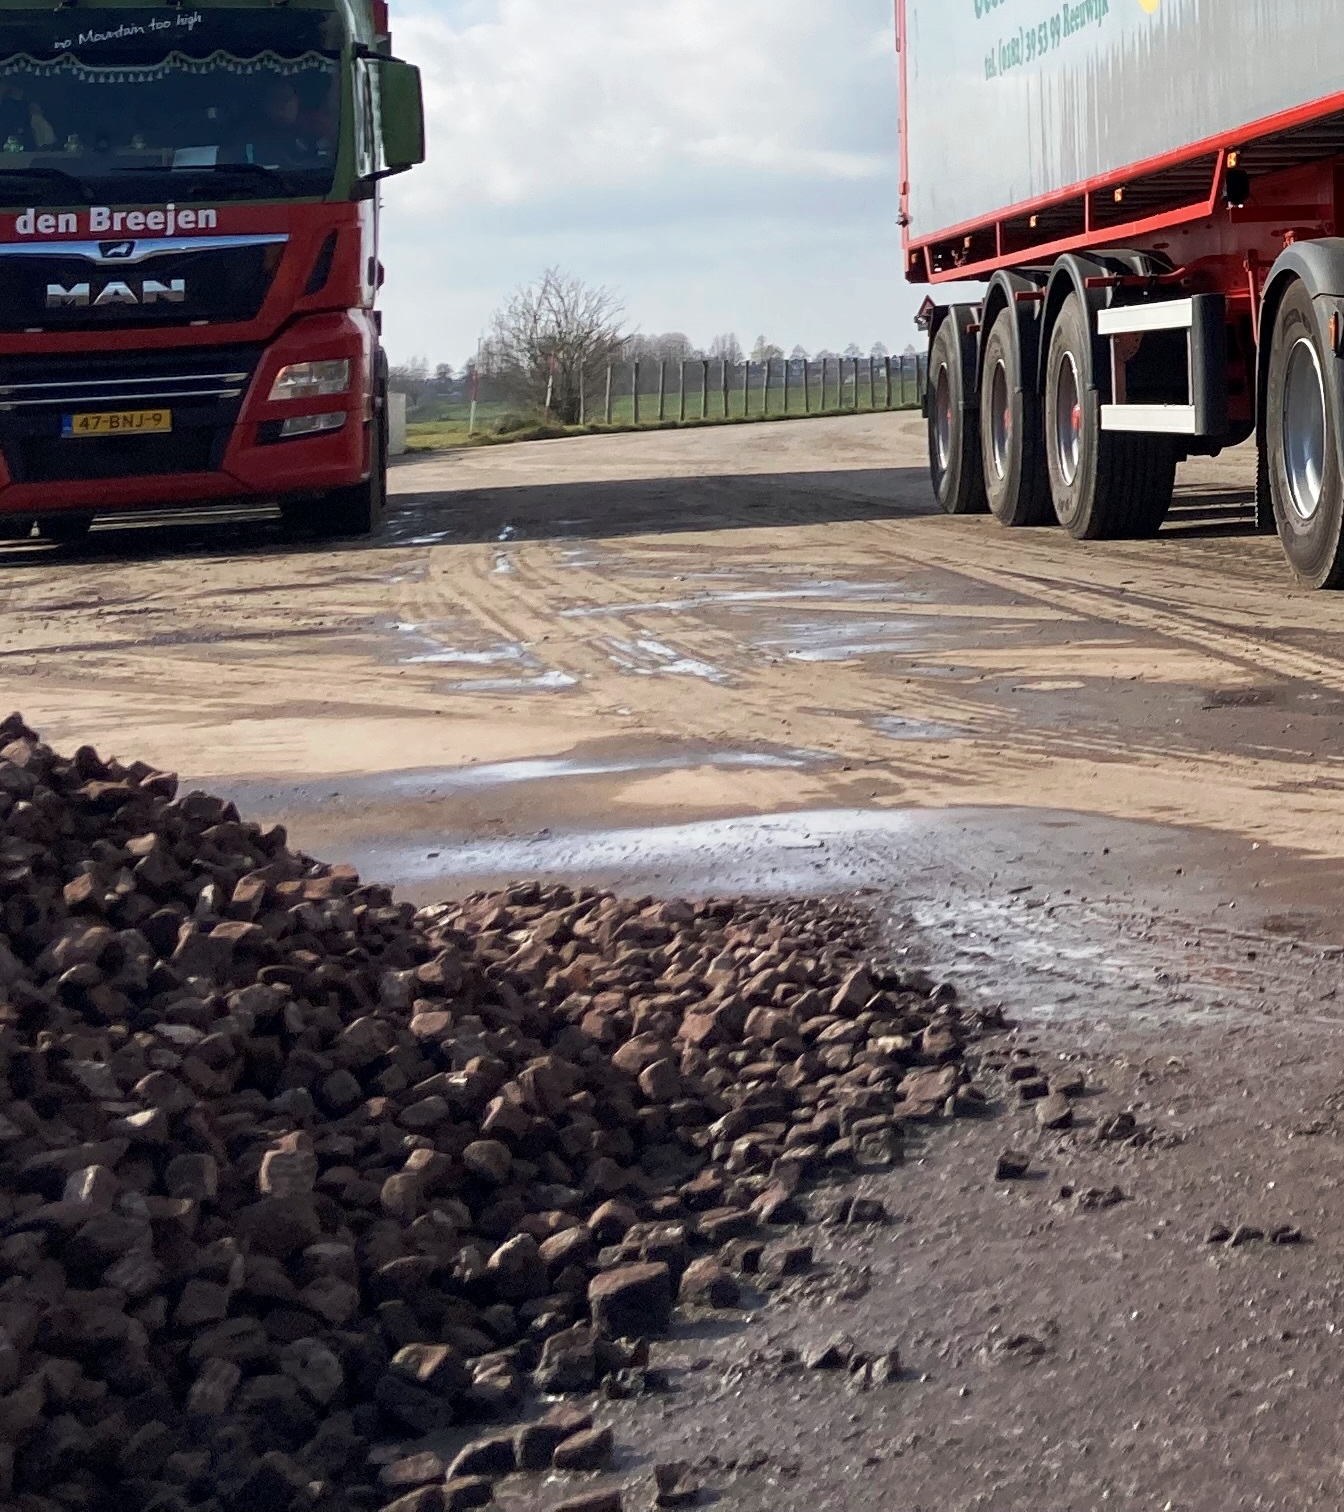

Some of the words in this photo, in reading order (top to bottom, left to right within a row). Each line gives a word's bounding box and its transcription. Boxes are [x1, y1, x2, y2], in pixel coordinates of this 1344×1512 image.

[78, 23, 145, 45] Mountain
[148, 18, 171, 31] too
[176, 11, 202, 31] high
[1026, 28, 1037, 62] 39
[1038, 21, 1048, 56] 53
[1050, 13, 1061, 49] 99
[15, 208, 77, 234] den
[89, 203, 217, 236] Breejen
[46, 279, 186, 308] MAN
[79, 413, 163, 430] 47-BNJ-9
